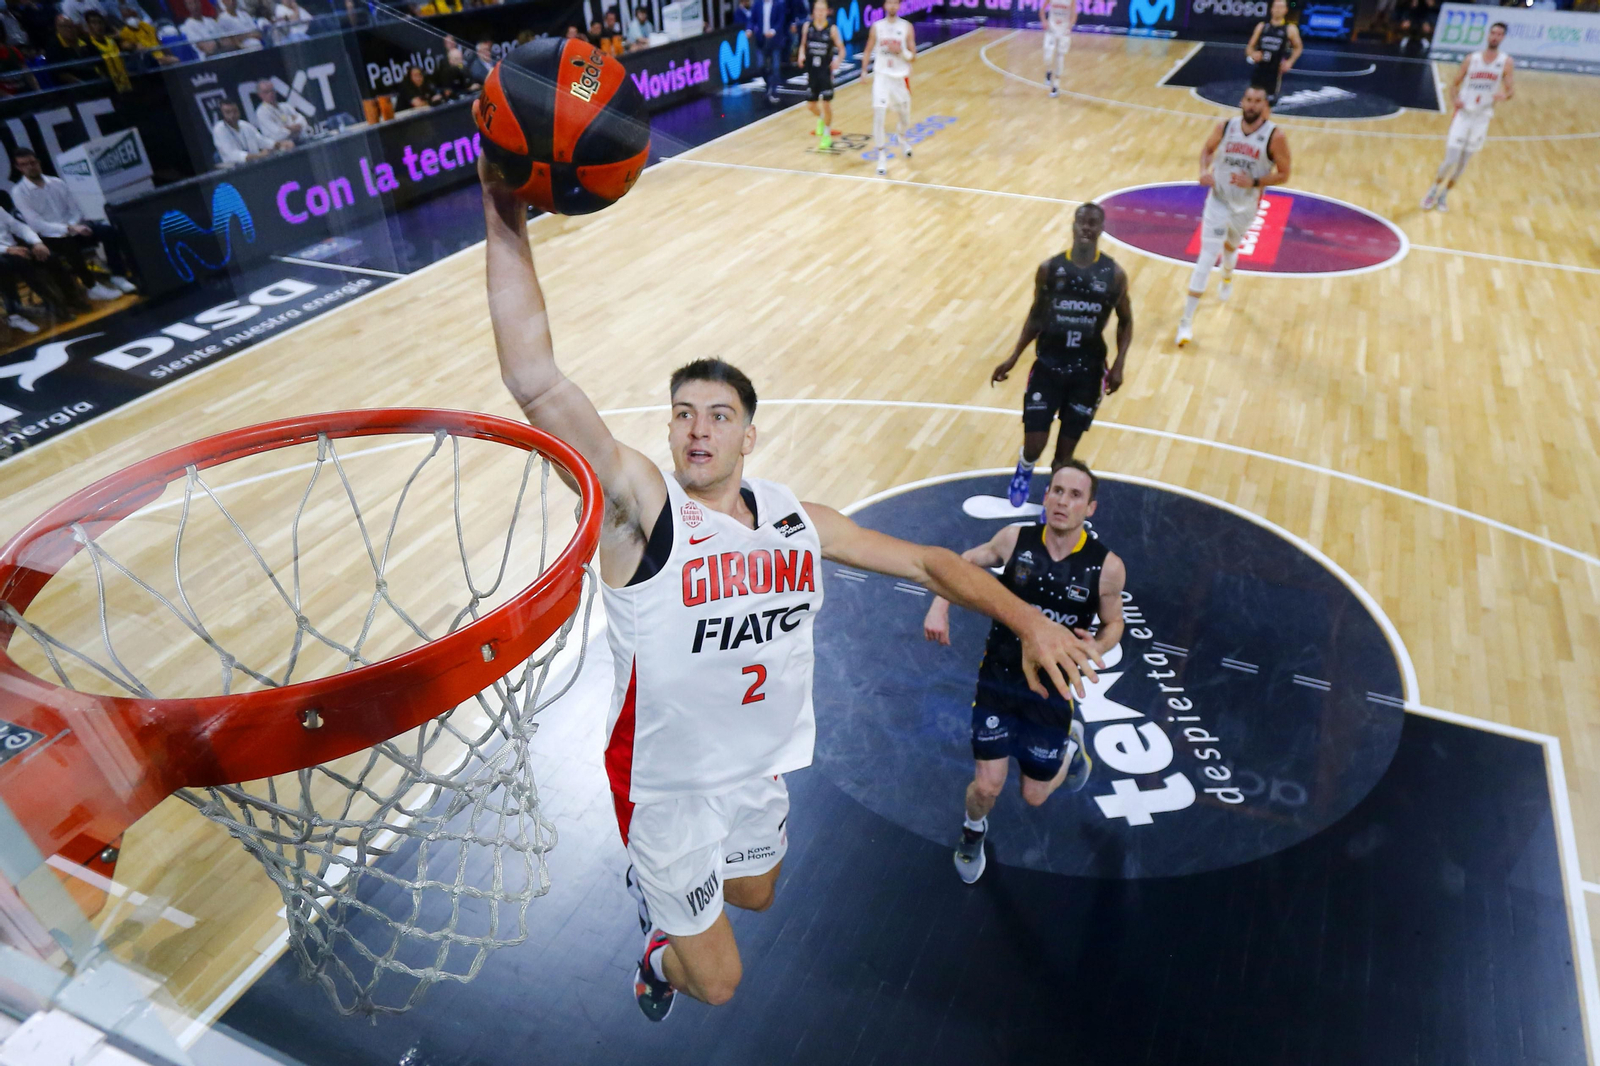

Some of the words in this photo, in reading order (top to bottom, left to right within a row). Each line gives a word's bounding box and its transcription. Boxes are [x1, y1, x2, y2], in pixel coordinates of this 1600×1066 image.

[276, 176, 355, 225] Con
[359, 156, 400, 198] la
[1053, 298, 1102, 313] Lenovo
[150, 343, 223, 380] siente
[224, 308, 302, 347] nuestra
[1066, 330, 1082, 348] 12
[682, 549, 815, 607] GIRONA
[691, 602, 811, 654] FIATC
[741, 663, 767, 706] 2
[747, 845, 771, 855] Kave
[747, 851, 776, 861] Home
